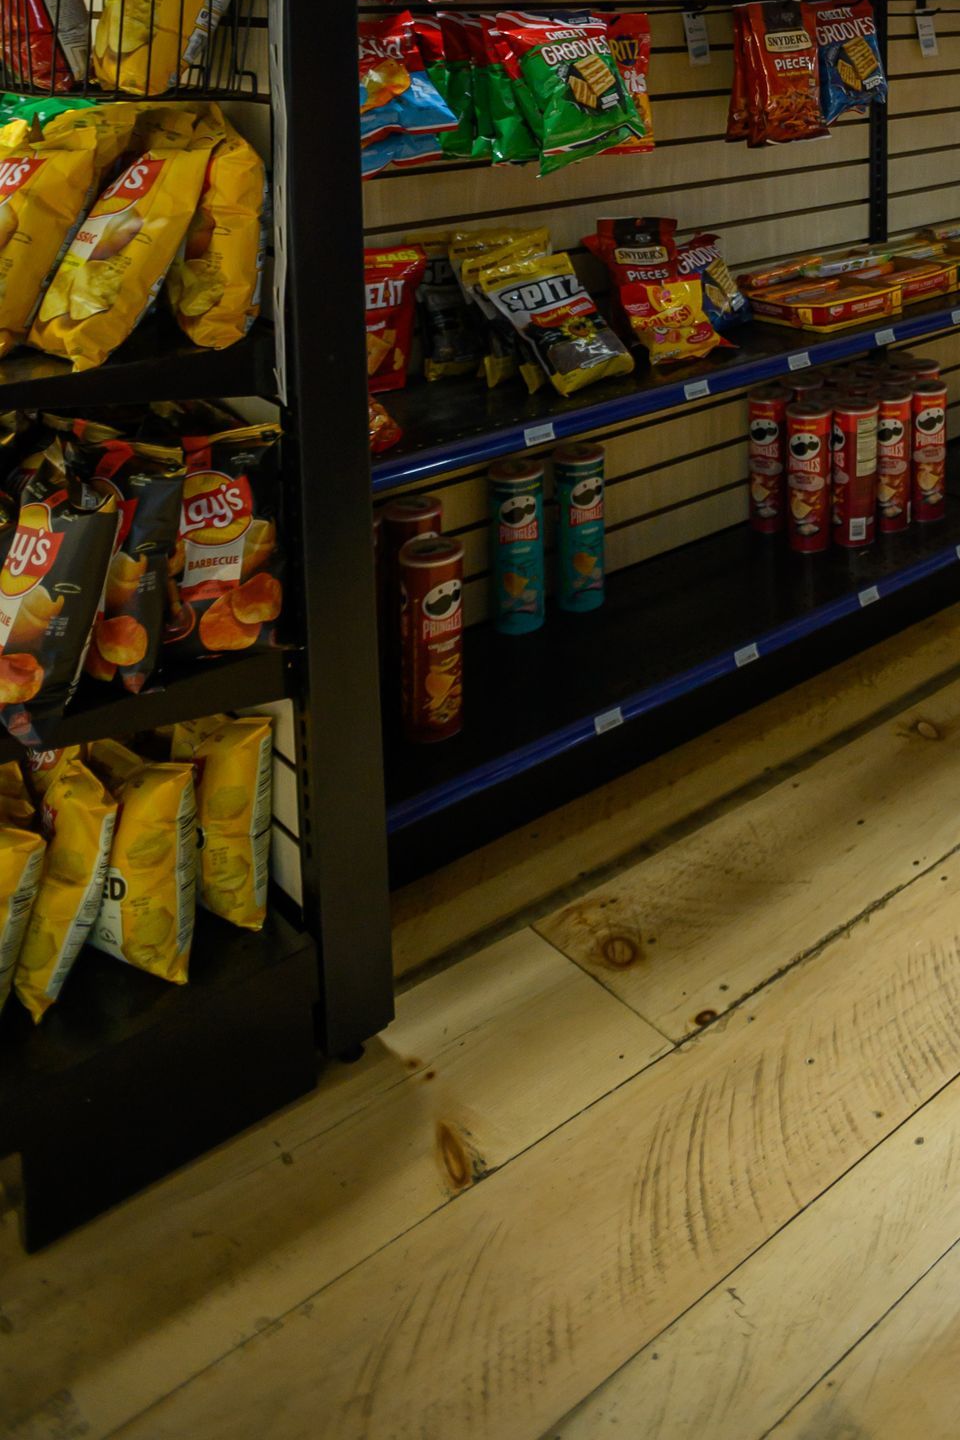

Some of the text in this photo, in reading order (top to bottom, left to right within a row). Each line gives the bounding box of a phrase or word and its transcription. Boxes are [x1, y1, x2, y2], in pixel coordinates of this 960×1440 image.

[766, 32, 811, 47] SNYDER'S
[815, 17, 877, 46] GROOVES
[540, 35, 612, 66] GROOVES
[624, 69, 647, 93] its
[618, 248, 664, 261] SNYDER'S
[627, 268, 670, 282] PIECES
[499, 276, 585, 313] SPITZ
[180, 483, 244, 532] Lay's
[498, 519, 539, 544] PRINGLES
[188, 554, 240, 571] BARBECUE
